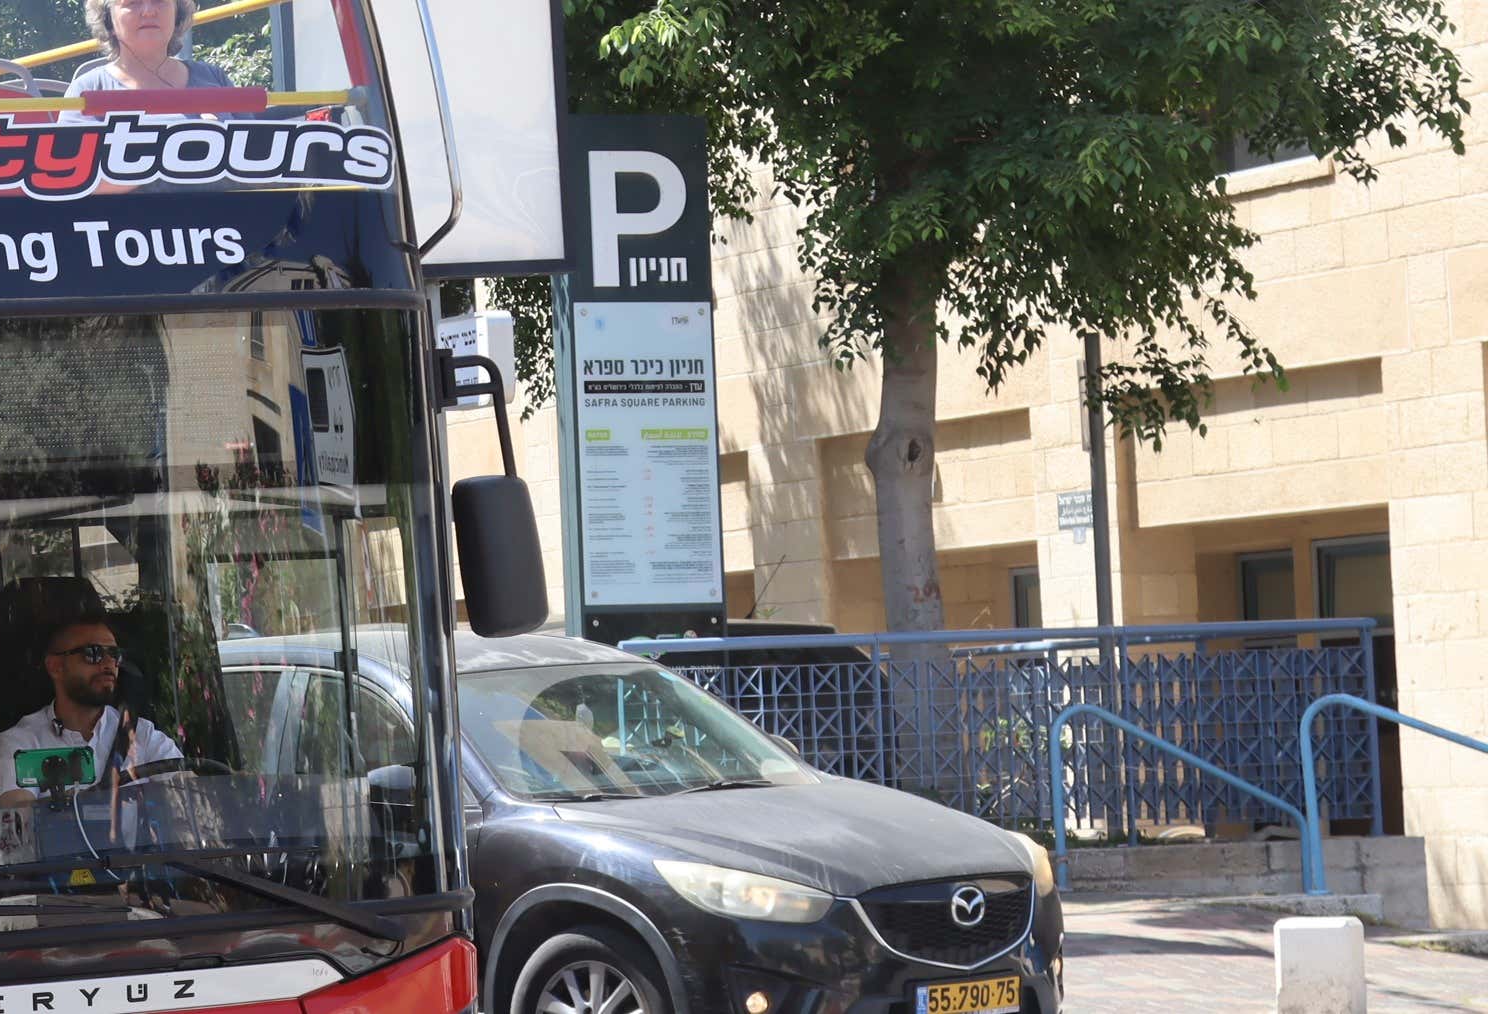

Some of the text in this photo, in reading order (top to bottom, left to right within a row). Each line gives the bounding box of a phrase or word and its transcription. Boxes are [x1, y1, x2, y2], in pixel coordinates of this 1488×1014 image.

[588, 150, 686, 287] P
[73, 220, 245, 269] Tours
[629, 257, 688, 287] חניון
[584, 359, 704, 378] חניון כיכר ספרא
[584, 397, 705, 408] SAFRA SQUARE PARKING
